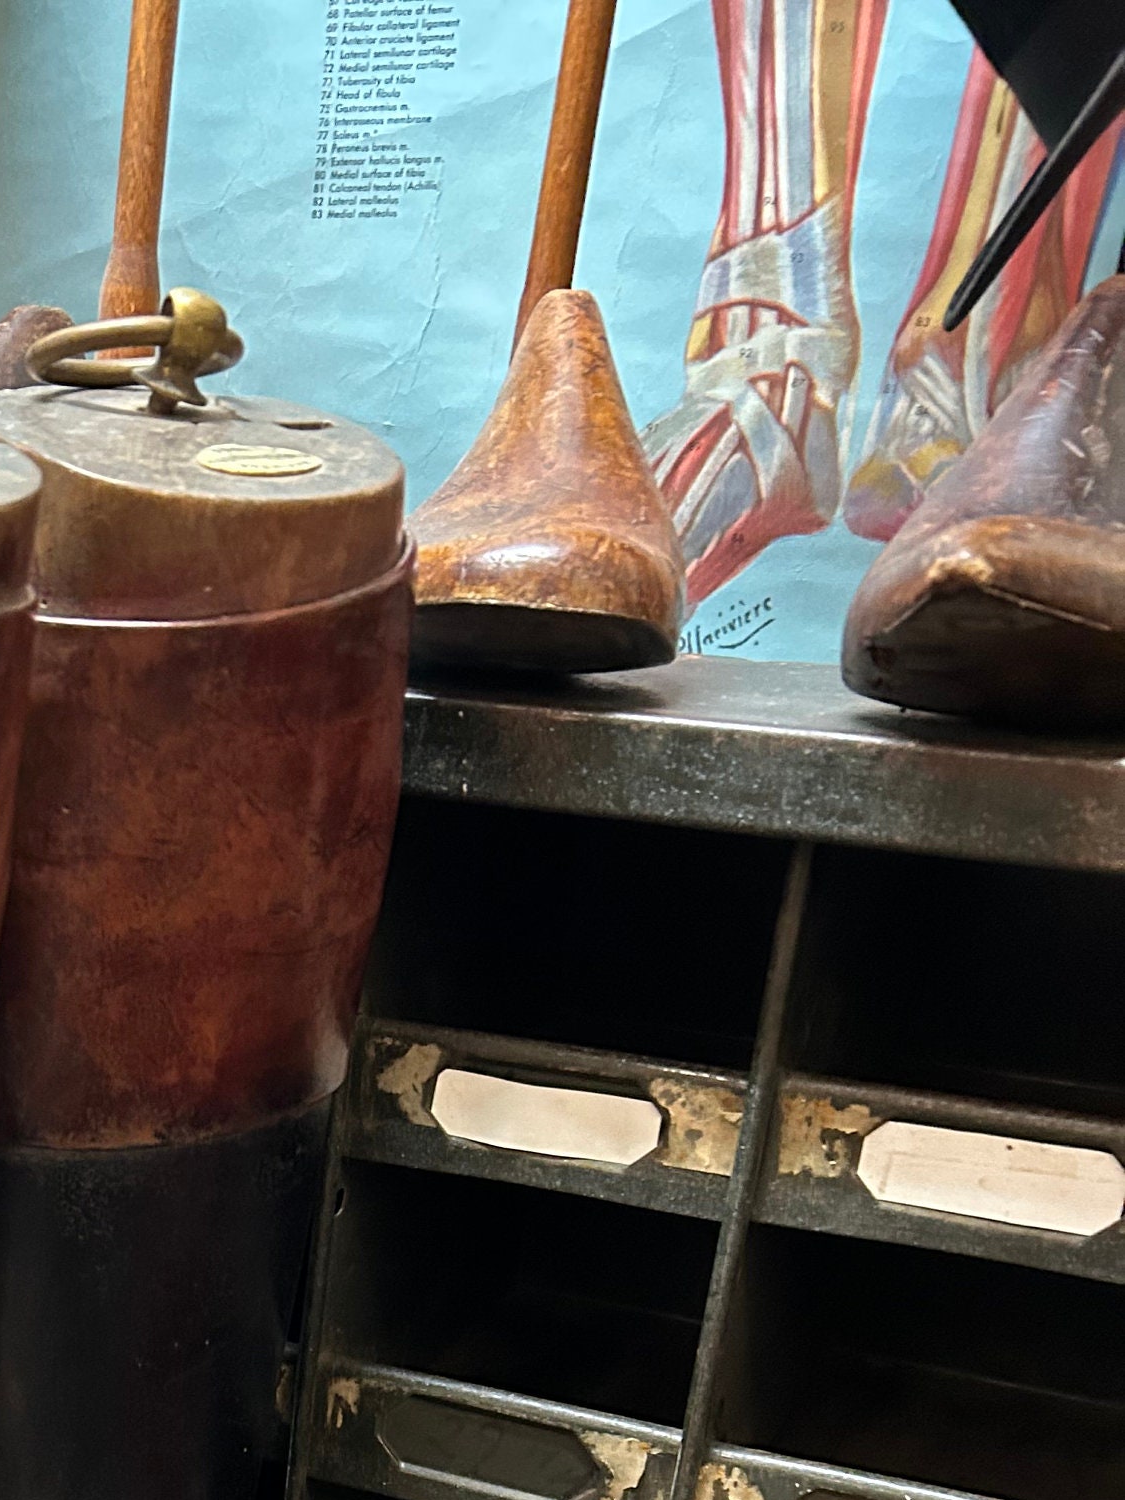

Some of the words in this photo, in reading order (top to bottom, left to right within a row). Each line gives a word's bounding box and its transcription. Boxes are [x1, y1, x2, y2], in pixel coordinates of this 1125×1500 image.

[416, 5, 425, 14] of
[324, 50, 334, 59] 71
[385, 75, 394, 84] of
[336, 90, 359, 99] Head
[364, 89, 373, 98] of
[317, 131, 328, 140] 77
[394, 168, 403, 177] of
